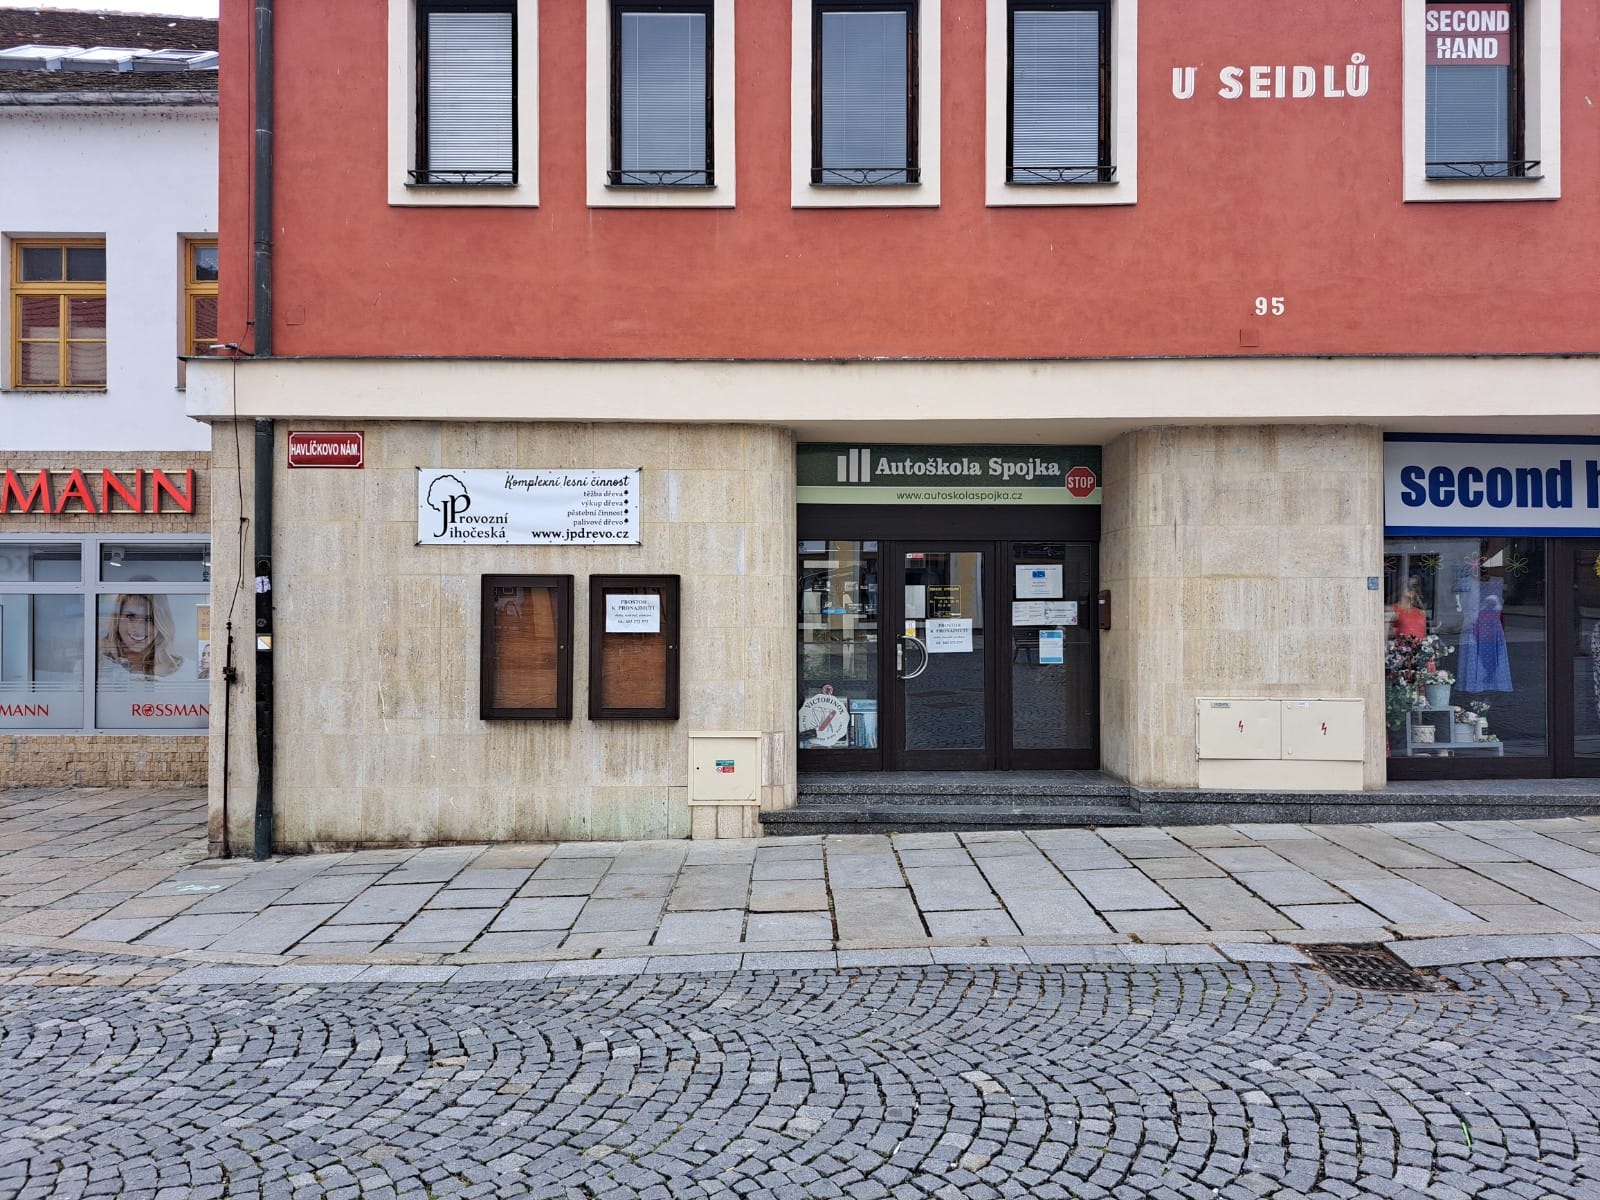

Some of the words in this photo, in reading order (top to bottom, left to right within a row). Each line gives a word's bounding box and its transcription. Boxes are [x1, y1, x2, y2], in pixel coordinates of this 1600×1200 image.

[1426, 10, 1510, 31] SECOND
[1437, 37, 1498, 58] HAND
[1172, 67, 1195, 99] U
[1218, 52, 1369, 99] SEIDLŮ
[1255, 296, 1285, 315] 95
[291, 440, 339, 456] HAVLÍČKOVO
[340, 440, 360, 456] NÁM.
[875, 457, 982, 475] Autoškola
[988, 457, 1061, 480] Spojka
[0, 468, 193, 514] MANN
[505, 475, 560, 492] Komplexní
[563, 475, 588, 487] lesní
[591, 474, 629, 487] činnost
[1067, 476, 1094, 489] STOP
[1400, 459, 1572, 508] second
[581, 499, 603, 508] výkup
[896, 490, 1023, 502] www.autoskolaspojka.cz
[603, 518, 624, 526] dřevo
[531, 528, 629, 541] www.jpdrevo.cz
[0, 703, 49, 717] MANN
[804, 696, 844, 715] VICTORINOX
